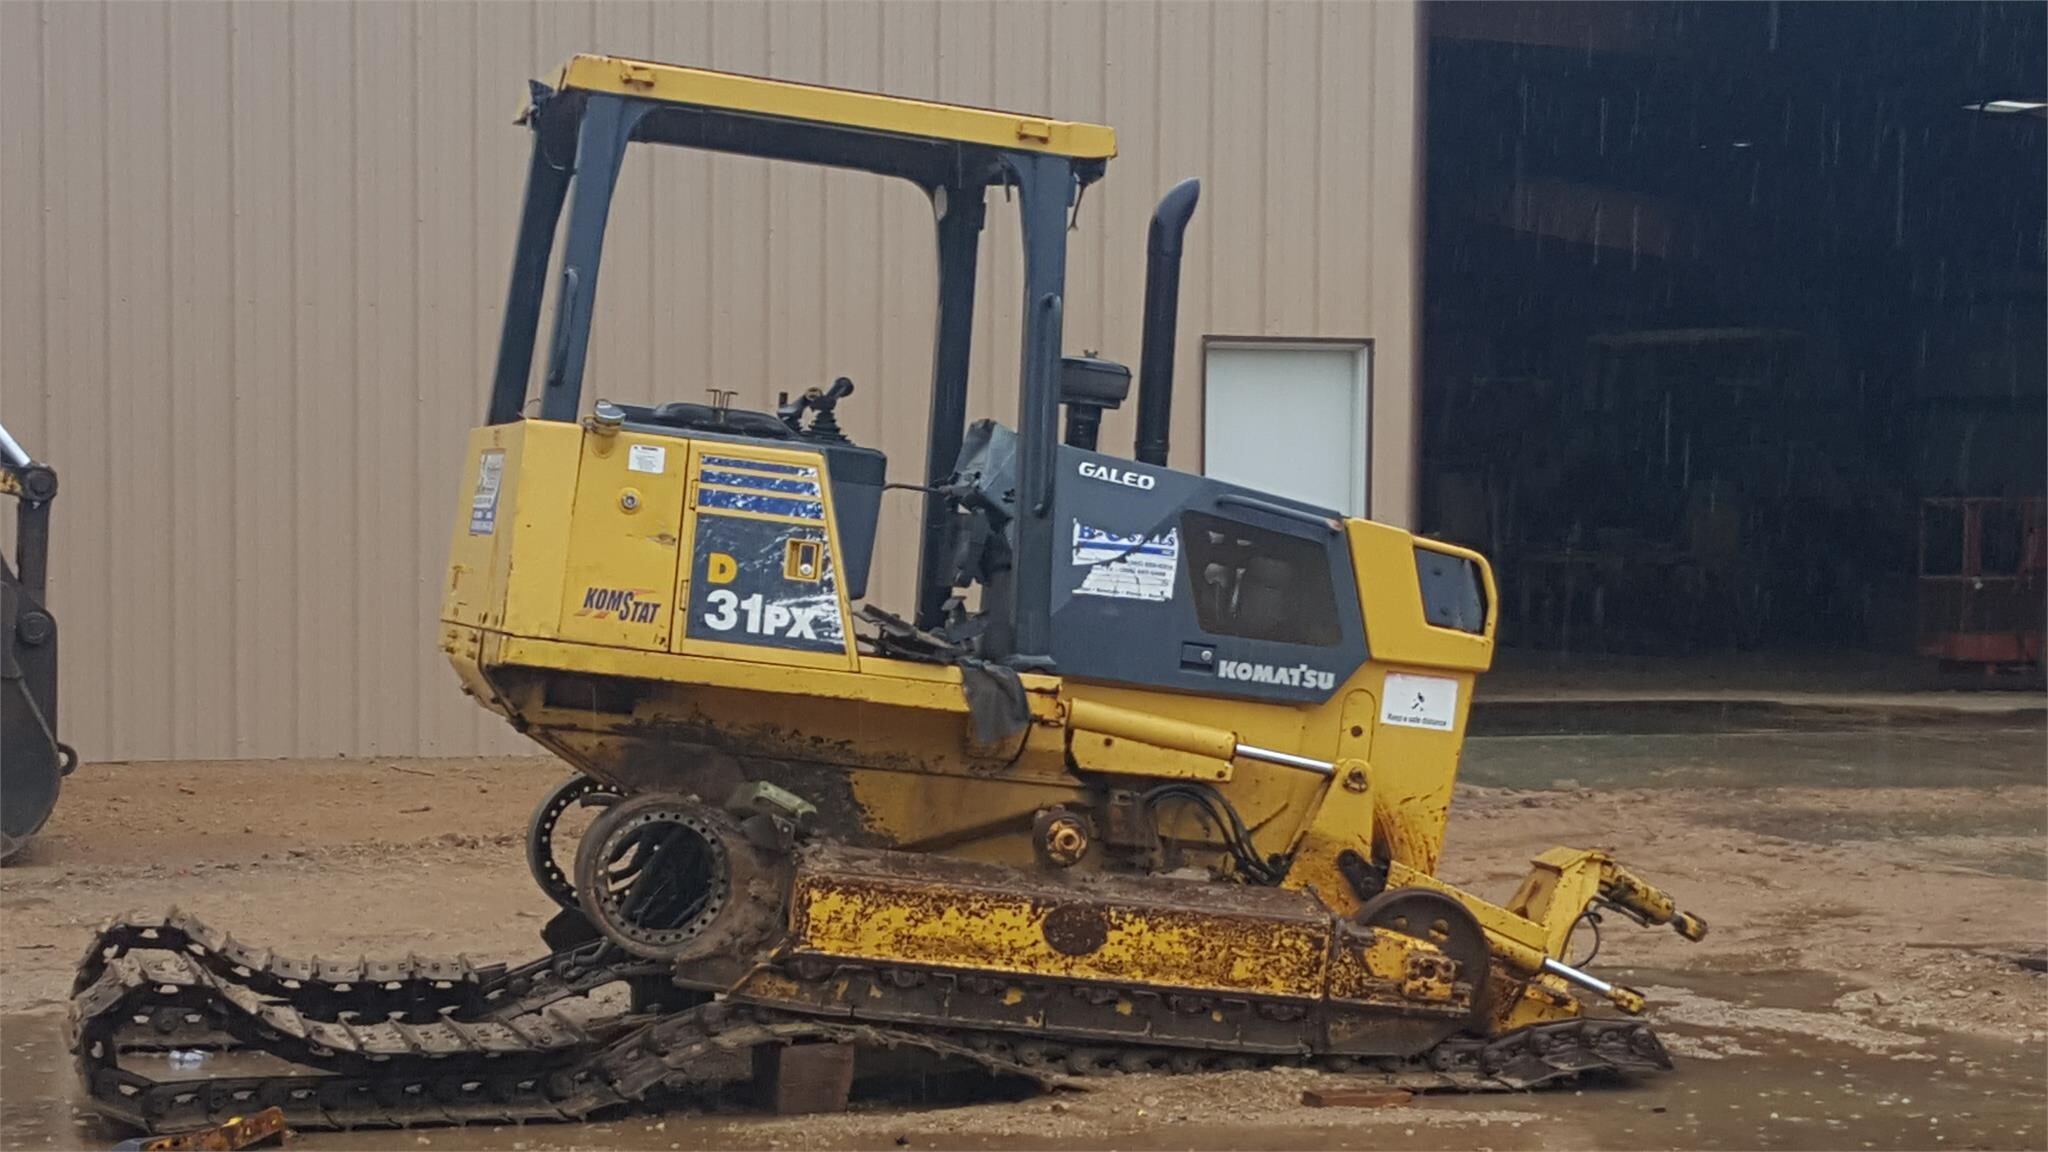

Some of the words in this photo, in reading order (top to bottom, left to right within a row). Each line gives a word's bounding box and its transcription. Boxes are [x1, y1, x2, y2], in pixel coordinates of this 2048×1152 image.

[1079, 461, 1155, 490] GALEO
[707, 552, 738, 584] D
[583, 587, 662, 624] KOMSTAT
[704, 589, 818, 640] 31PX
[1218, 659, 1336, 690] KOMATSU
